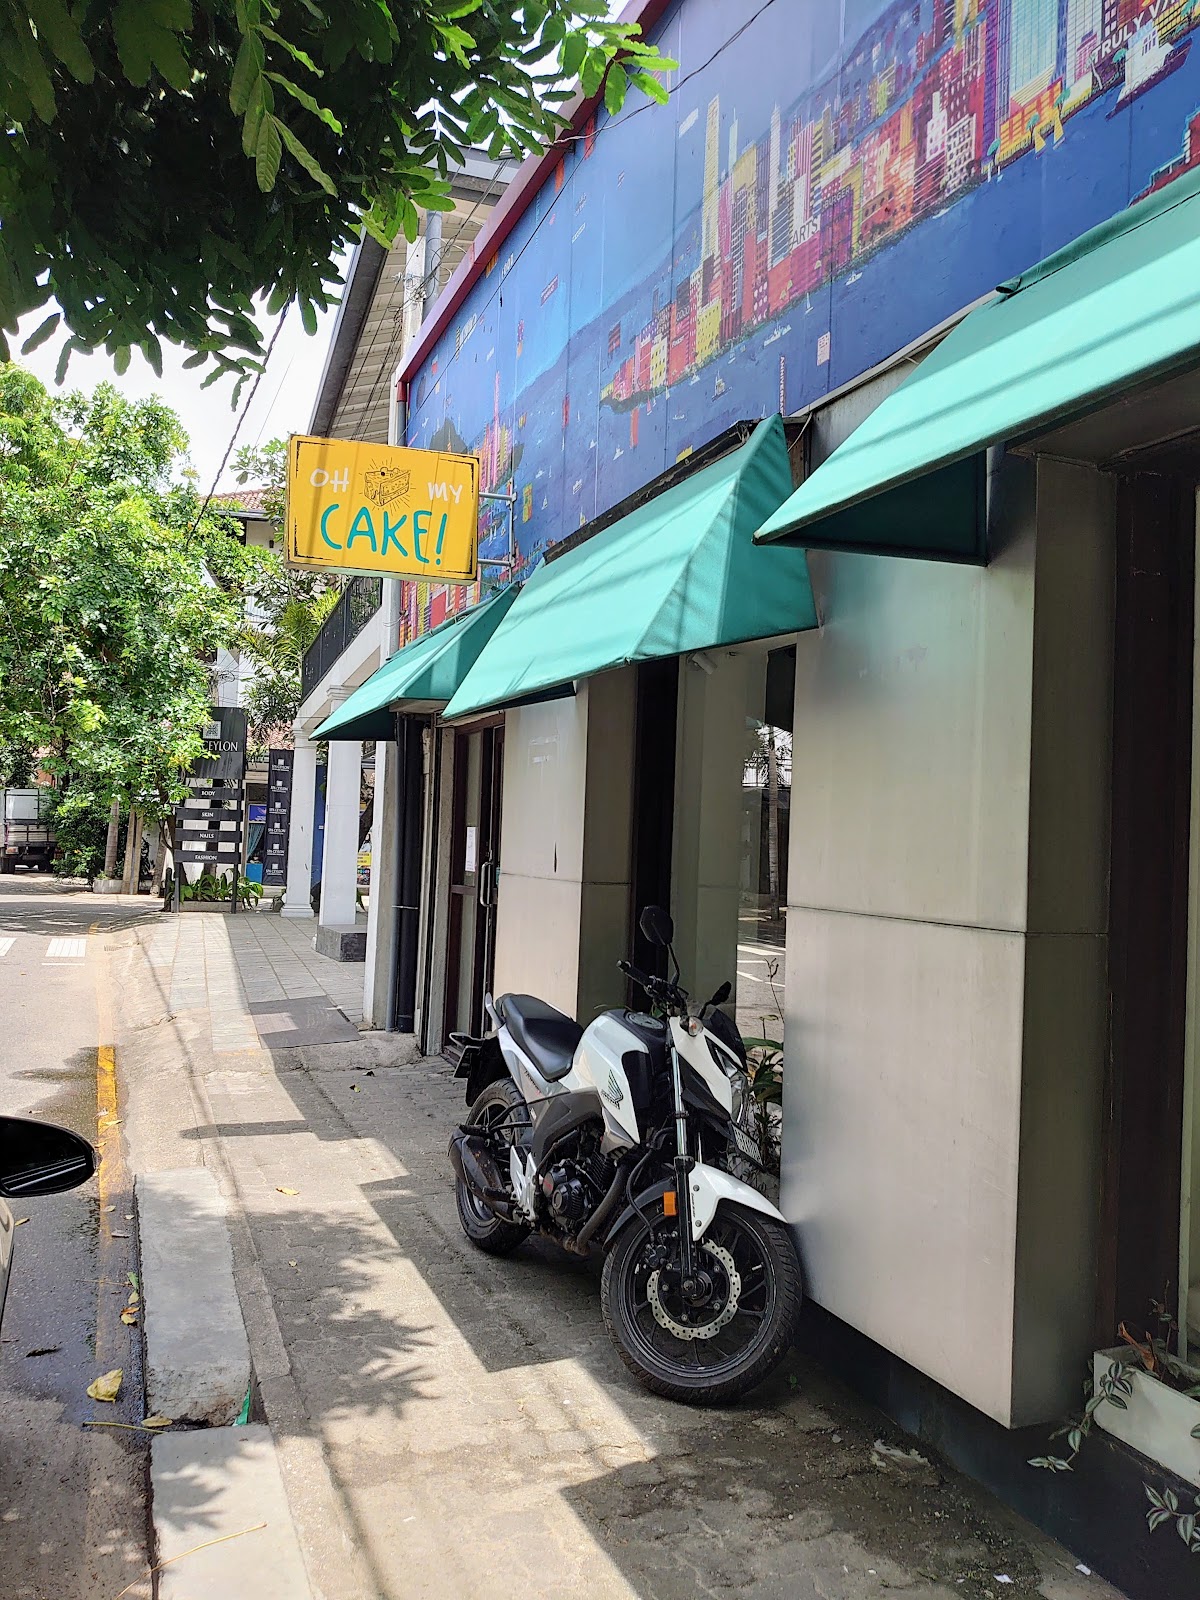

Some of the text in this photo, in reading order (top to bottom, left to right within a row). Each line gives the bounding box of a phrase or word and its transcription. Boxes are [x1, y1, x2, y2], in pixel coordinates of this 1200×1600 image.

[1092, 11, 1144, 64] TRULY
[791, 220, 818, 246] ARTS
[309, 468, 463, 504] OH MY
[320, 503, 448, 565] CAKE!
